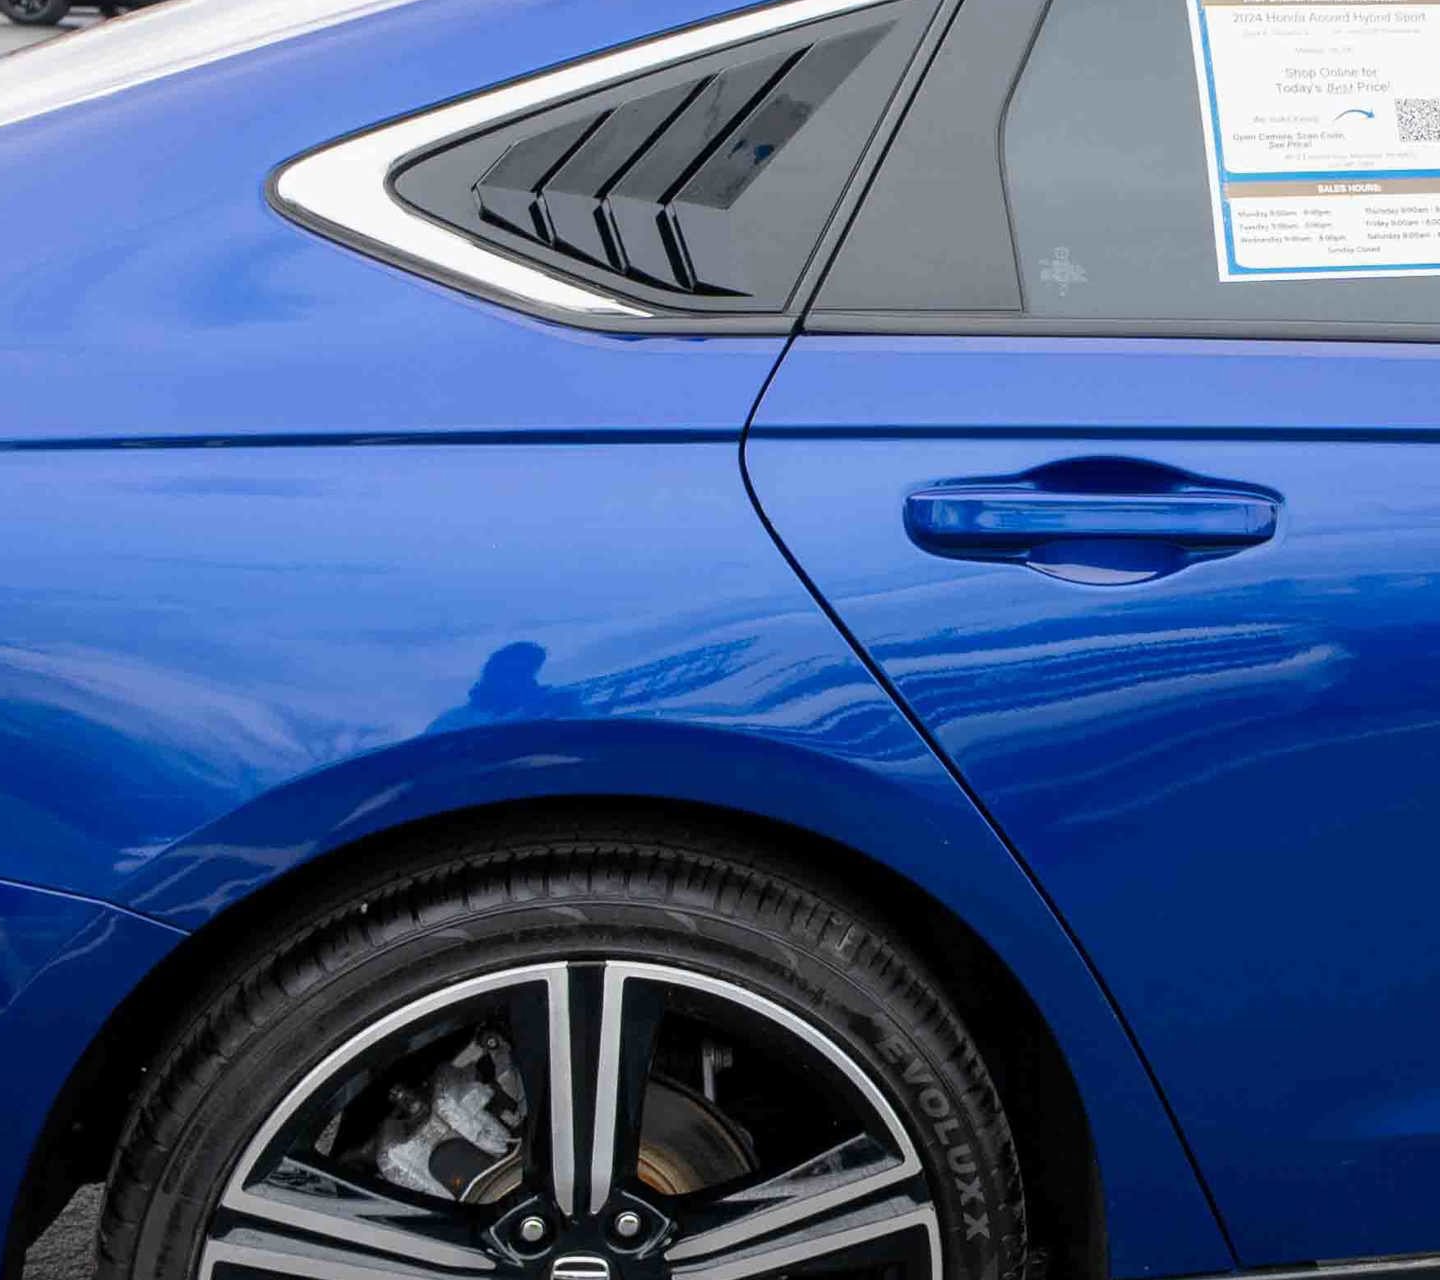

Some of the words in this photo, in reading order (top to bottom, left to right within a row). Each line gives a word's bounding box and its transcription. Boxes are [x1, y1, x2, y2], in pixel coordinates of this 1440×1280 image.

[1232, 12, 1262, 23] 2024
[1266, 11, 1305, 23] Honda
[1285, 67, 1316, 79] Shop
[875, 1034, 991, 1241] EVOLUXX
